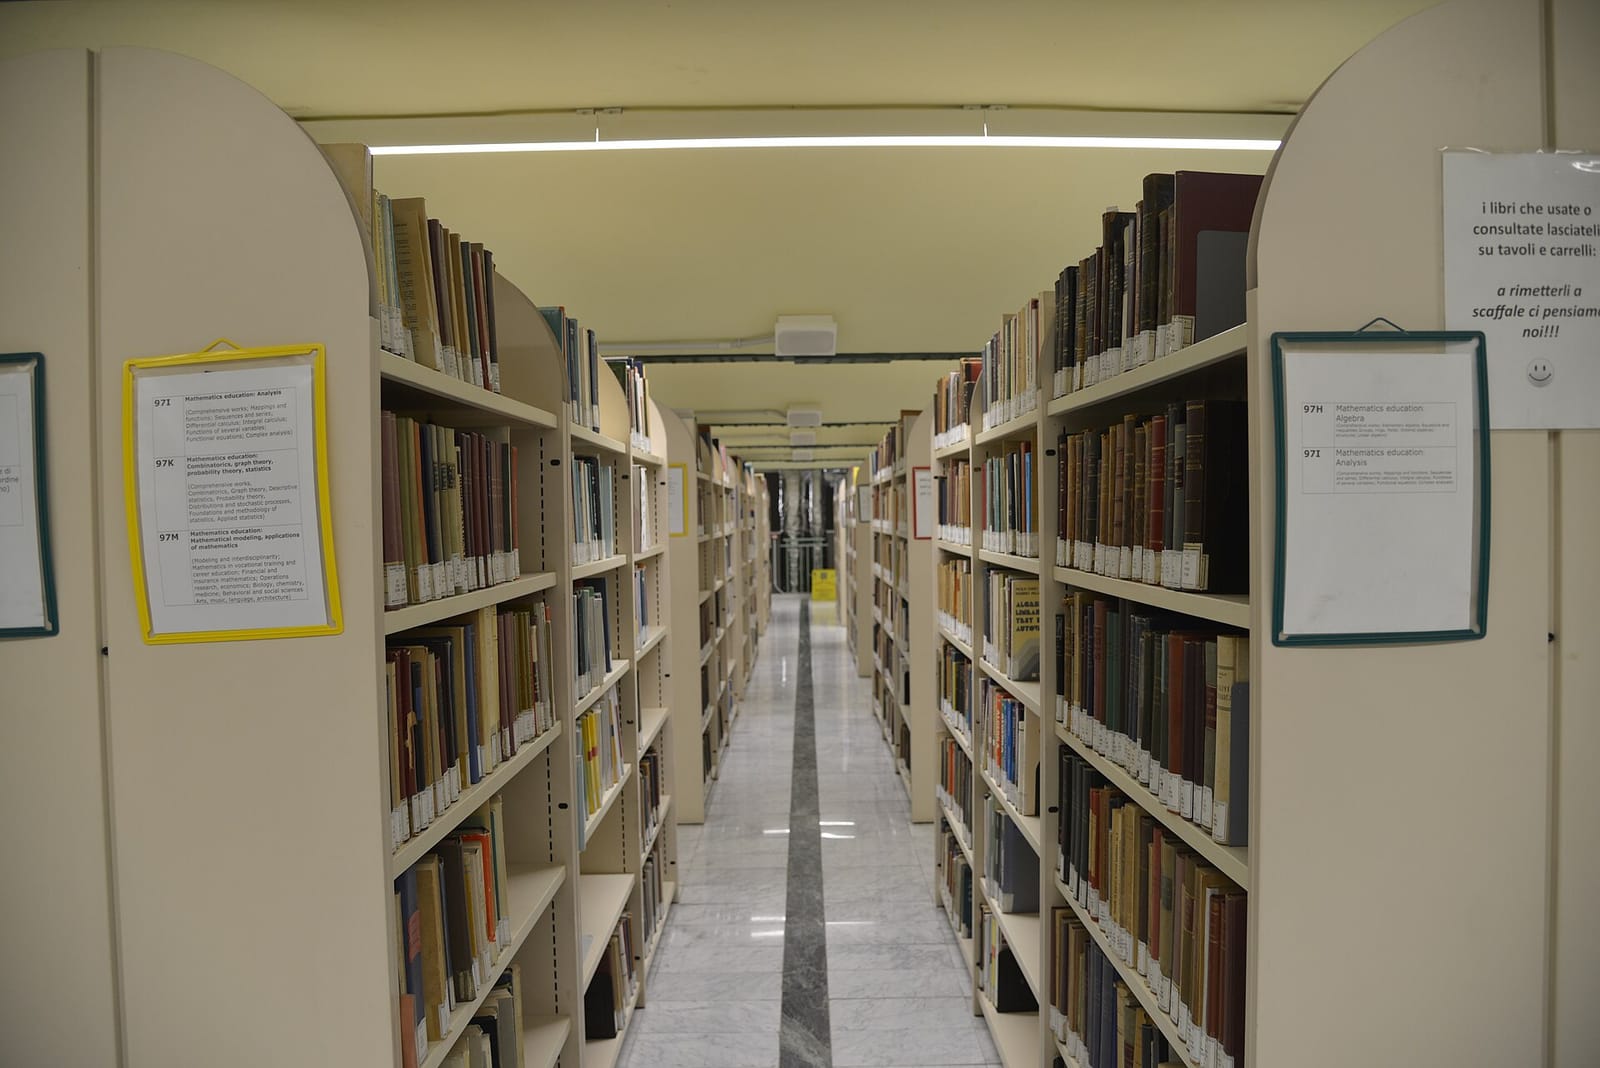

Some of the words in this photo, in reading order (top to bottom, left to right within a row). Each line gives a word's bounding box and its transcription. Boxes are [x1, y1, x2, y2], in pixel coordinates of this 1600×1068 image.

[1482, 202, 1486, 214] i
[1490, 202, 1516, 214] libri
[1519, 202, 1544, 214] che
[1548, 204, 1580, 216] usate
[1584, 205, 1592, 216] o
[1473, 222, 1544, 236] consultate
[1548, 222, 1600, 237] lasciateli
[1478, 246, 1494, 256] su
[1498, 243, 1535, 256] tavoli
[1540, 246, 1546, 256] e
[1550, 244, 1596, 256] carrelli:
[1497, 287, 1506, 296] a
[1510, 284, 1571, 297] rimetterli
[1574, 287, 1582, 296] a
[1472, 304, 1525, 320] scaffale
[1528, 304, 1540, 317] ci
[1522, 325, 1560, 338] noi!!!
[154, 399, 171, 407] 97I
[1304, 405, 1324, 414] 97H
[1386, 404, 1424, 412] education
[1336, 414, 1365, 423] Algebra
[1304, 450, 1320, 458] 97I
[156, 459, 174, 467] 97K
[265, 532, 299, 540] applications
